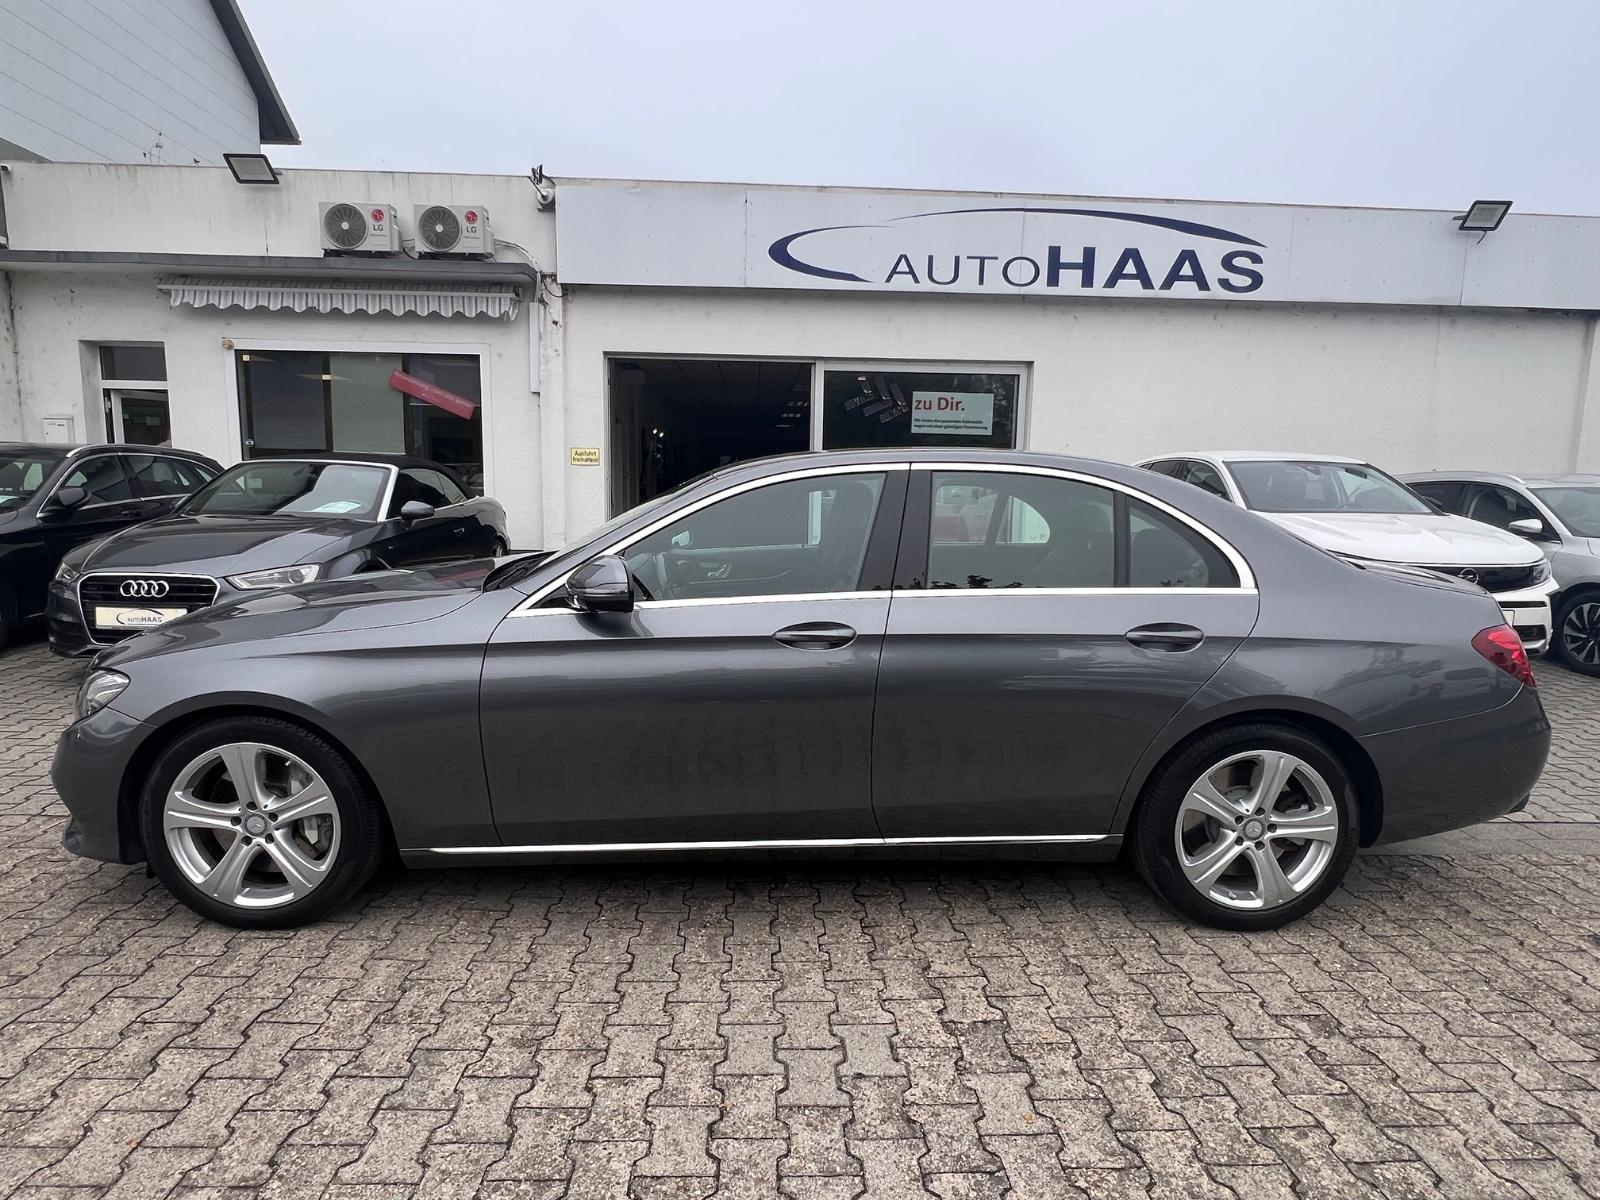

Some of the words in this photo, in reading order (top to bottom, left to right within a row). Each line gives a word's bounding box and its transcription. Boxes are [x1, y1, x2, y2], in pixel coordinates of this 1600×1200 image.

[373, 224, 384, 232] LG
[466, 226, 477, 234] LG
[914, 399, 932, 411] zu
[937, 396, 966, 412] Dir.
